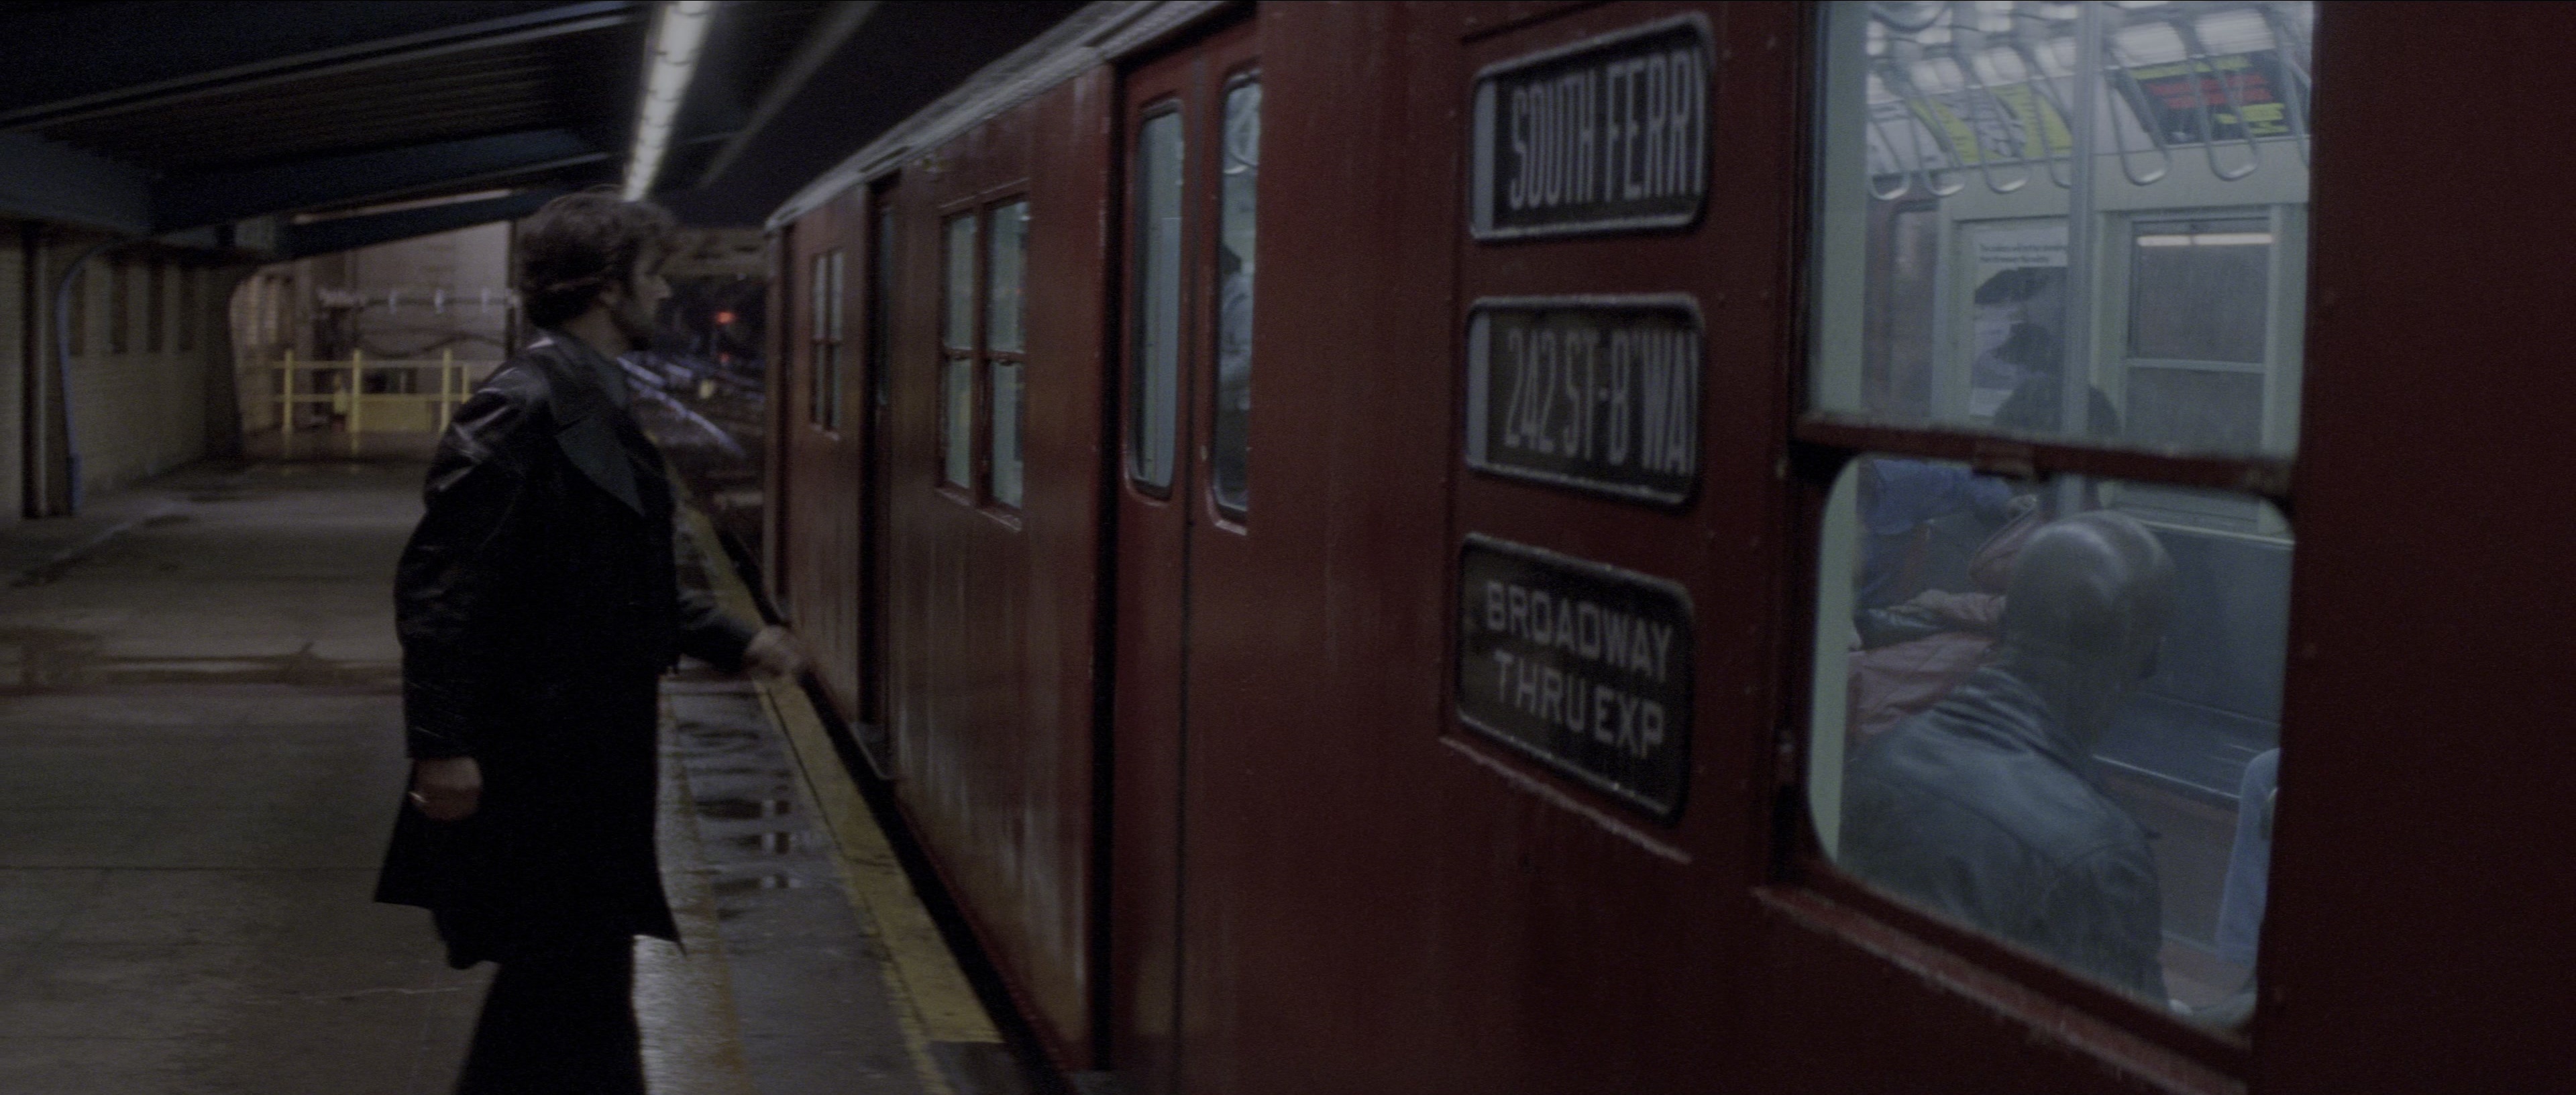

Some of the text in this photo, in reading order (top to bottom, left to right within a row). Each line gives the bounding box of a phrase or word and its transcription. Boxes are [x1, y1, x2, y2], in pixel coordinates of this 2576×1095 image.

[1509, 70, 1597, 210] SOUTH
[1504, 327, 1555, 454] 242
[1487, 579, 1674, 684] BROADWAY
[1494, 648, 1664, 760] THRU EXP
